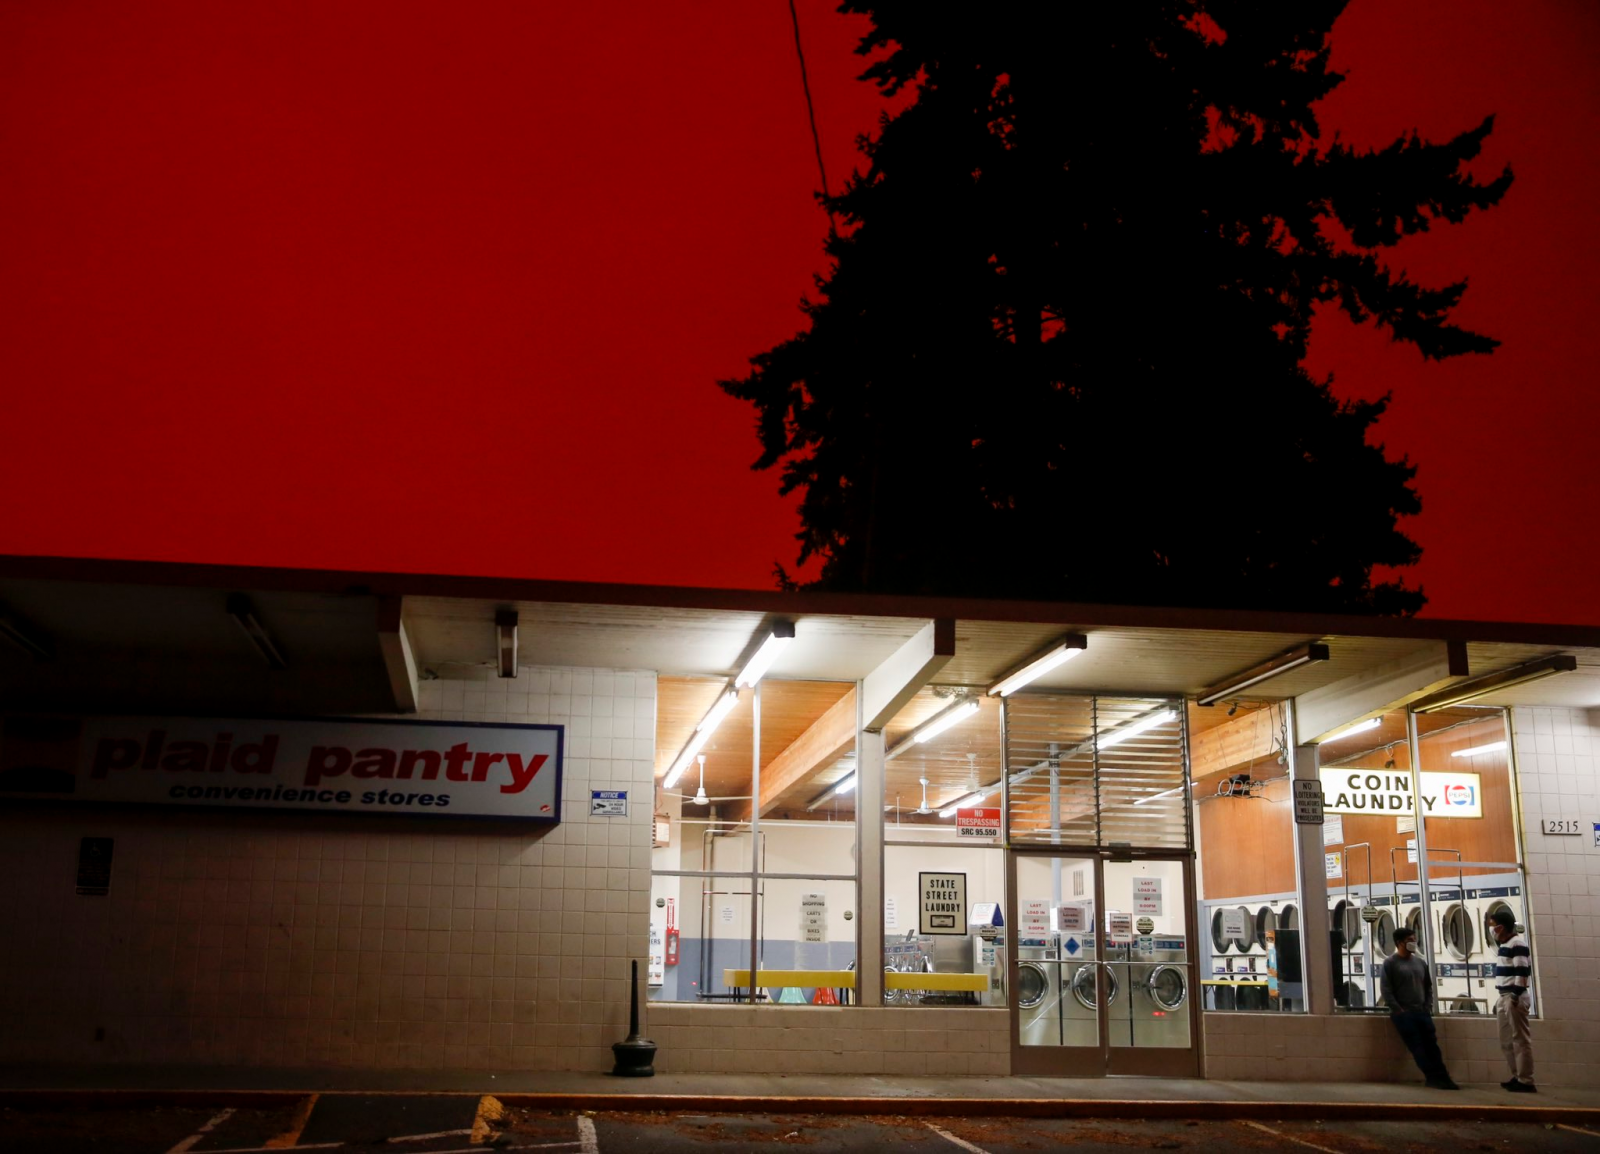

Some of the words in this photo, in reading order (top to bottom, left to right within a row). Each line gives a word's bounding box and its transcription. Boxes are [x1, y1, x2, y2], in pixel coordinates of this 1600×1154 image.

[90, 730, 279, 779] plaid
[303, 742, 550, 795] pantry
[1302, 782, 1312, 790] NO
[1347, 774, 1409, 791] COIN
[168, 784, 352, 804] convenience
[360, 789, 451, 807] stores
[1296, 791, 1321, 799] LOITERING
[974, 809, 984, 818] NO
[958, 818, 1000, 827] TRESPASSING
[1549, 821, 1579, 832] 2515
[961, 828, 974, 836] SRC
[975, 828, 997, 836] 95.550
[930, 879, 955, 889] STATE
[926, 891, 958, 900] STREET
[925, 902, 961, 912] LAUNDRY
